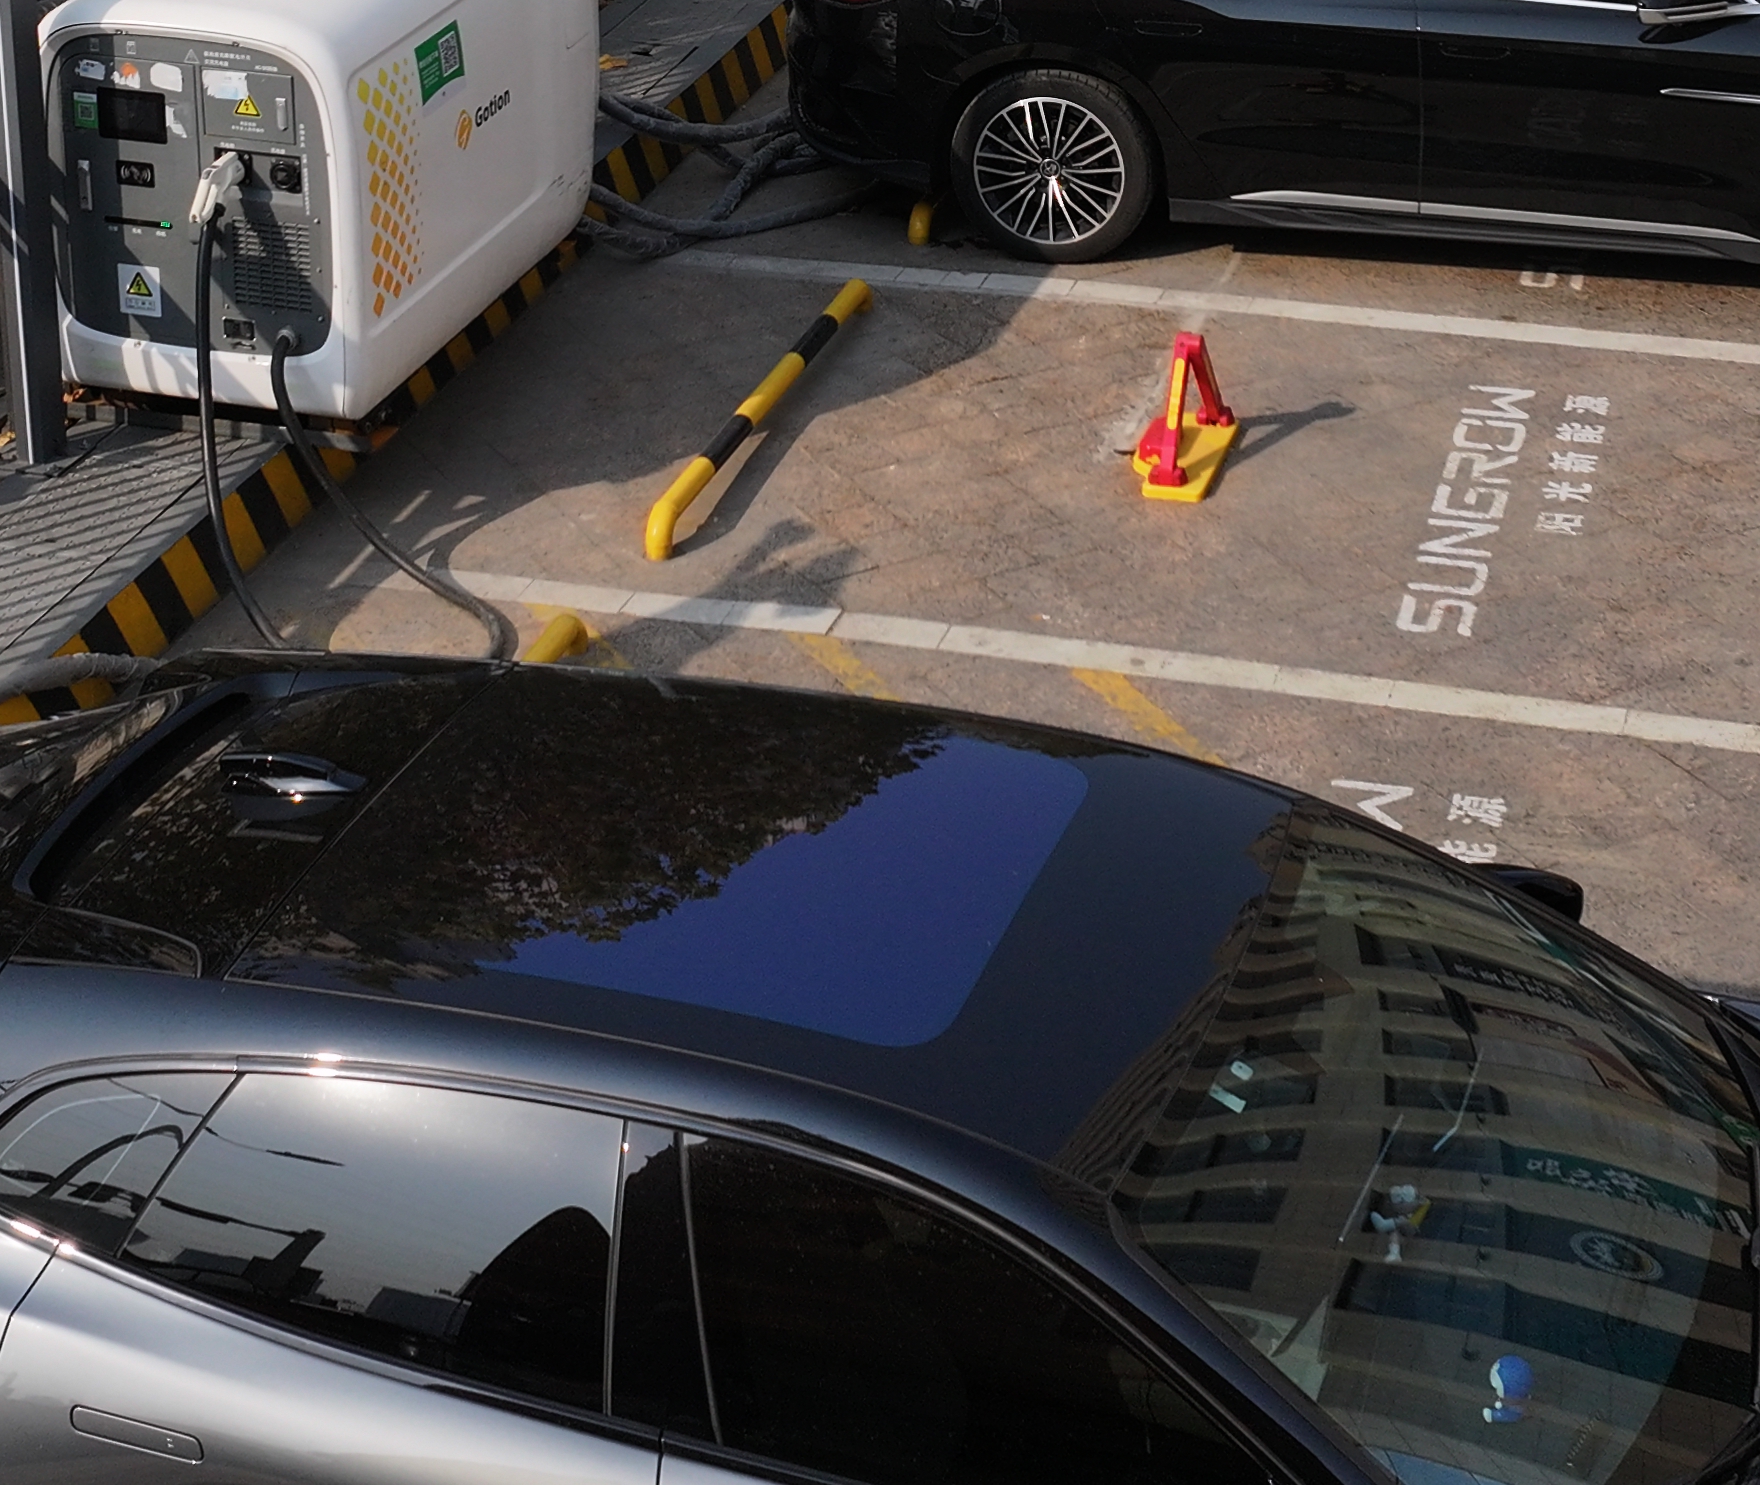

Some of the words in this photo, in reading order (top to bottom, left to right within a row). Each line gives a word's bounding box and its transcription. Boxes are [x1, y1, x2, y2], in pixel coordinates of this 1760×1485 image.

[474, 89, 511, 128] Gotion
[1395, 384, 1536, 637] SUNGROW
[1534, 392, 1610, 537] 阳光新能源
